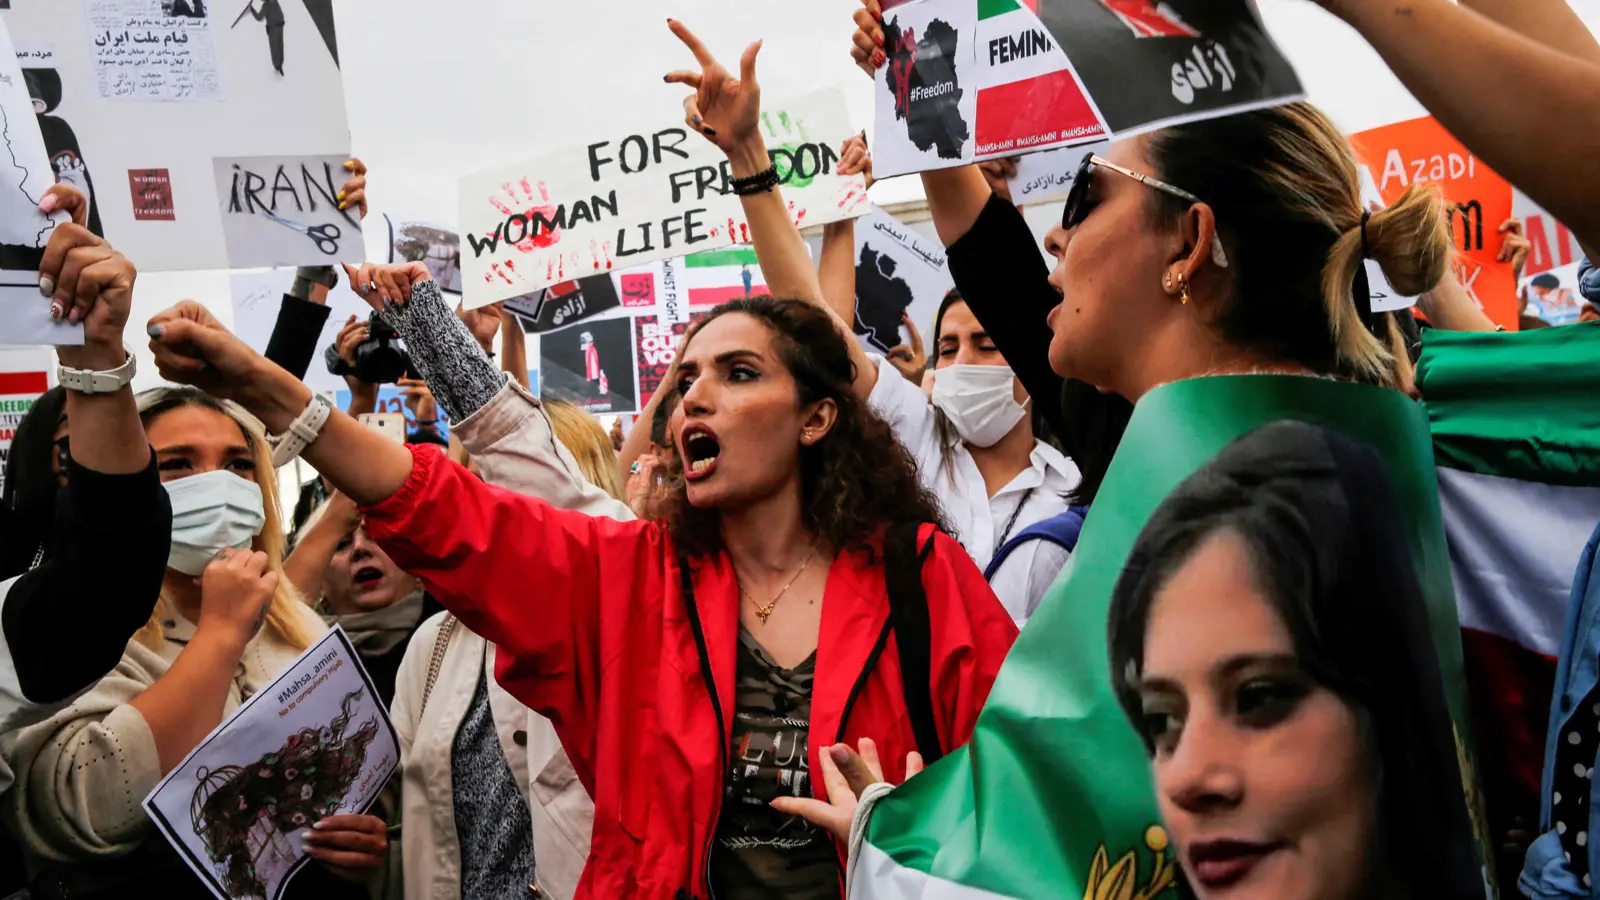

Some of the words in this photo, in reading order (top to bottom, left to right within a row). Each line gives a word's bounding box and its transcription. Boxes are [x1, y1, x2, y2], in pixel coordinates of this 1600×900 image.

[95, 30, 130, 47] ایران
[133, 31, 160, 44] ملت
[164, 29, 189, 47] قیام
[97, 48, 113, 56] ایران
[114, 48, 126, 56] های
[112, 78, 136, 88] زندگی
[910, 81, 954, 102] #Freedom
[587, 128, 690, 183] FOR
[133, 175, 168, 183] woman
[144, 192, 161, 200] life
[134, 207, 175, 215] freedom
[467, 189, 619, 258] WOMAN
[615, 208, 709, 257] LIFE
[662, 257, 676, 290] MINIST
[665, 293, 679, 321] FIGHT
[643, 349, 677, 365] VO
[277, 647, 339, 704] #Mahsa_amini
[278, 708, 289, 719] No
